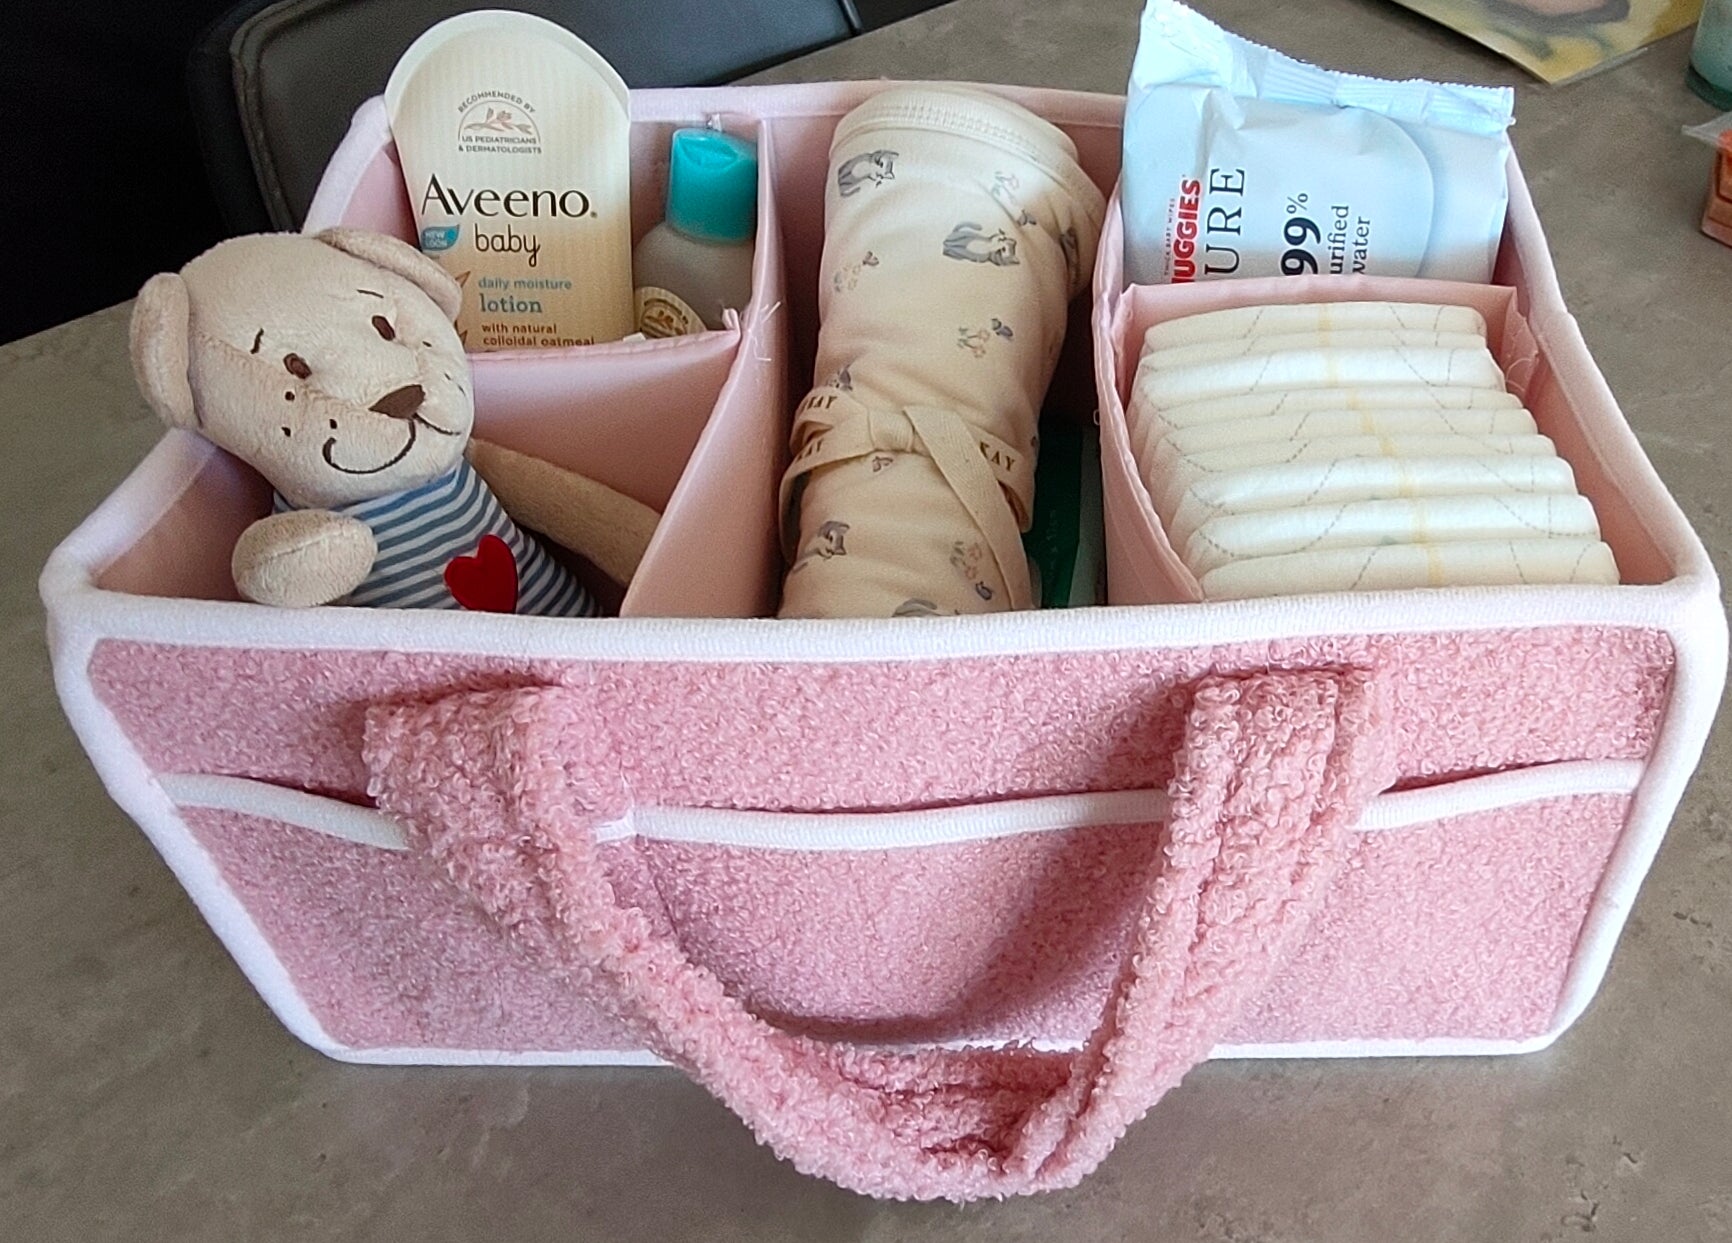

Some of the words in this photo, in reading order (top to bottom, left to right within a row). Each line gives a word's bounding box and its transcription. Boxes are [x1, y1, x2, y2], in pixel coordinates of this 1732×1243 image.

[457, 90, 523, 113] RECOMMENDED
[523, 103, 536, 113] BY
[462, 135, 473, 143] US
[475, 135, 537, 144] PEDIATRICIANS
[466, 145, 542, 154] DERMATOLOGISTS
[421, 173, 590, 218] Aveeno
[1204, 168, 1245, 275] URE
[474, 222, 541, 268] baby
[1327, 205, 1349, 274] urified
[478, 277, 509, 290] daily
[514, 279, 572, 290] moisture
[479, 292, 543, 313] lotion
[481, 323, 508, 334] with
[512, 323, 557, 334] natural
[483, 335, 537, 346] colloidal
[540, 335, 595, 346] oatmeal
